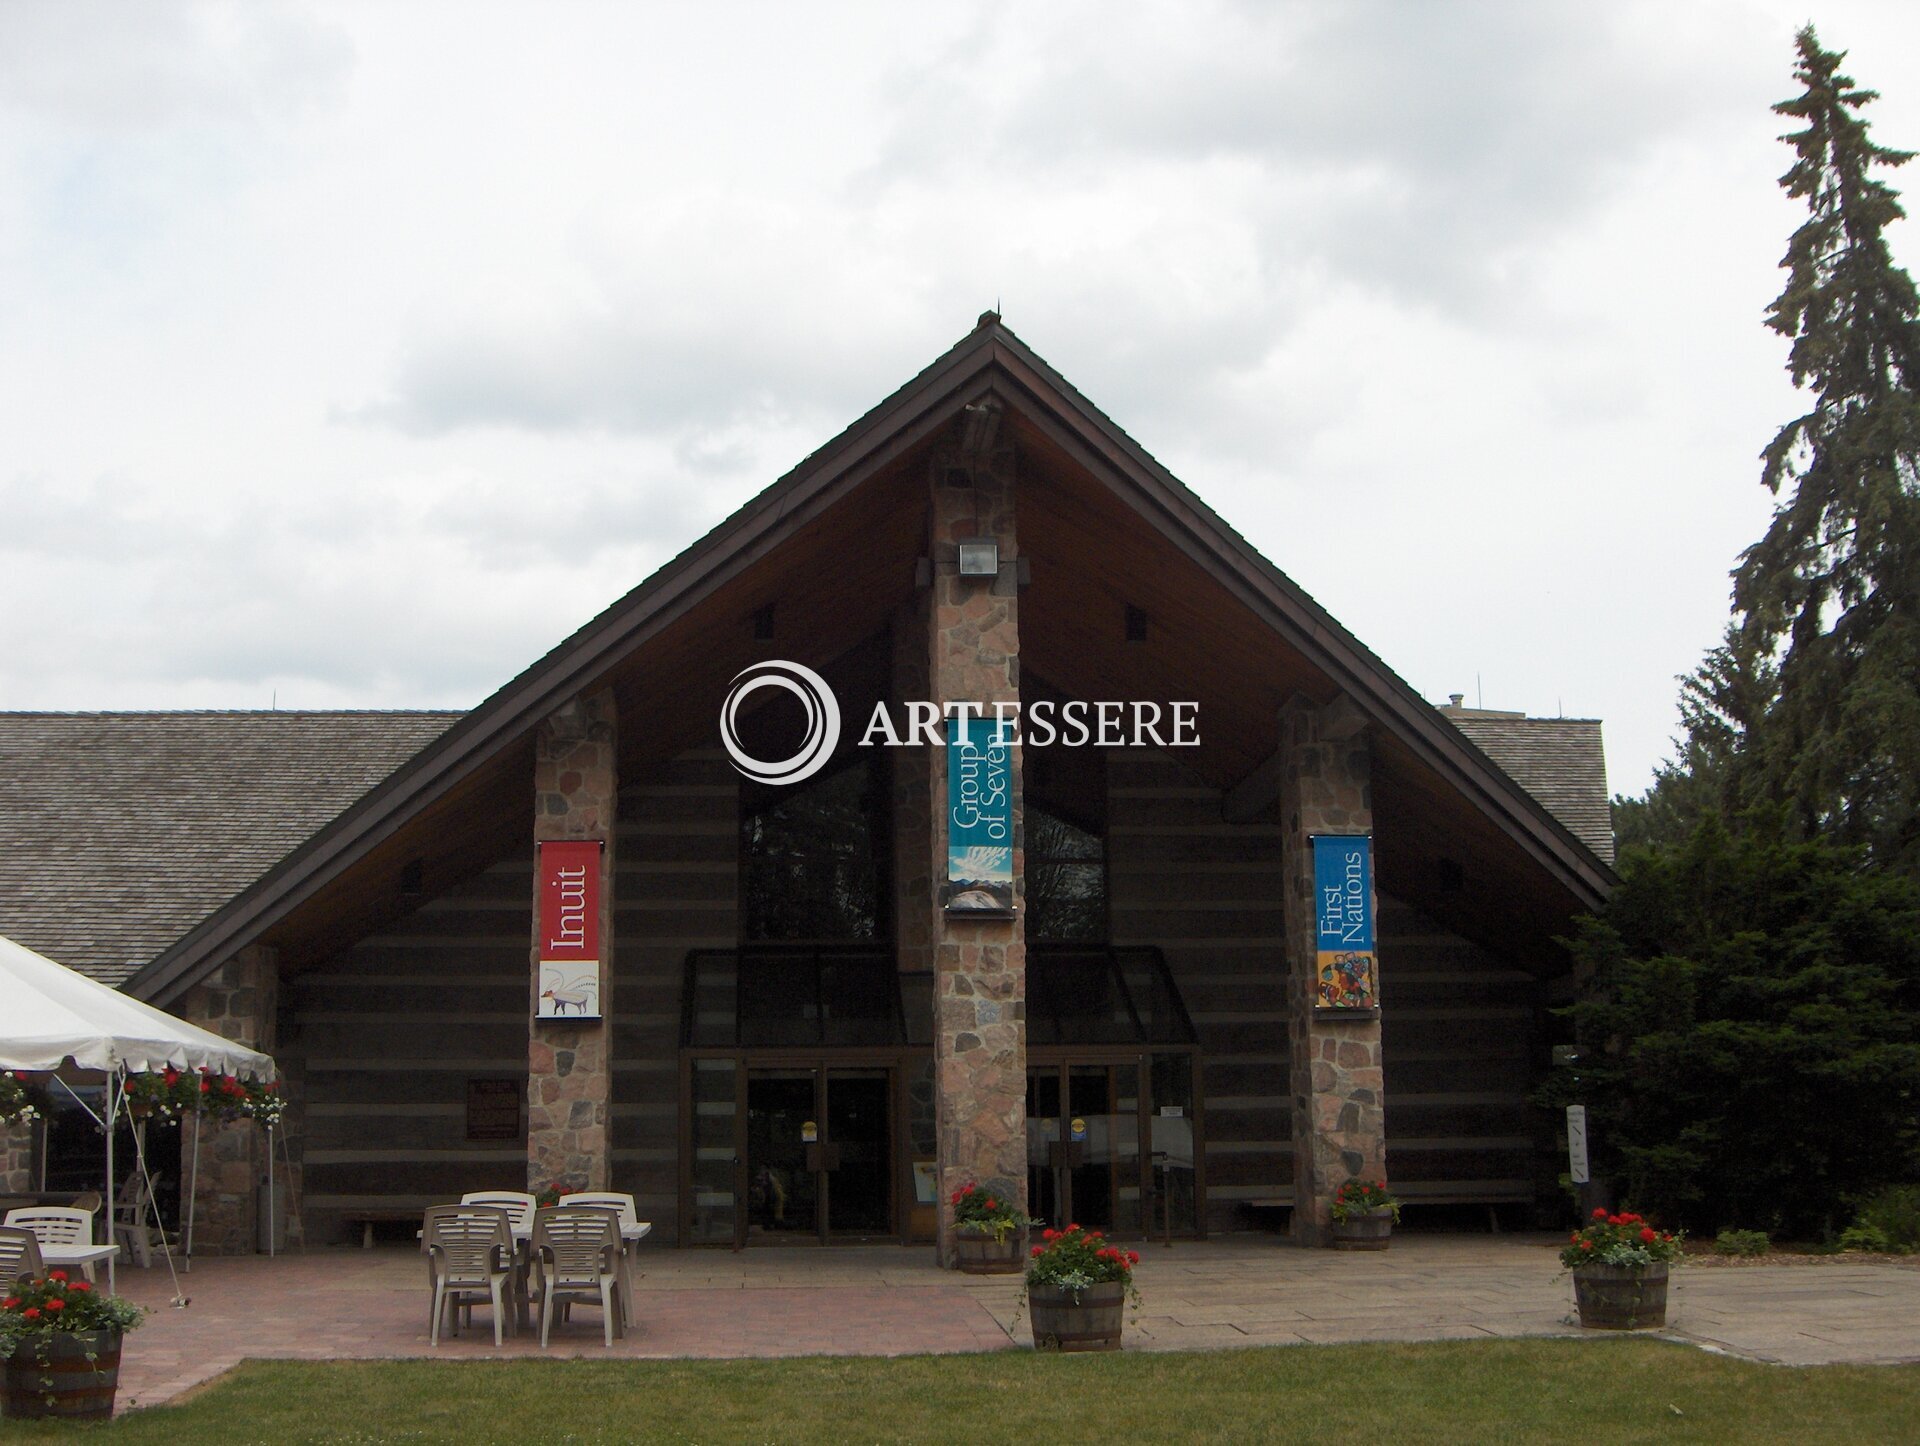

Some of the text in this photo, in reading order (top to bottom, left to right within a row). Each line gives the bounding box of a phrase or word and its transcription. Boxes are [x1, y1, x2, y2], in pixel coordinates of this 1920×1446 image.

[953, 743, 987, 829] Group
[978, 731, 1006, 840] of Seven
[550, 865, 586, 951] Inuit
[1320, 884, 1343, 937] First
[1342, 852, 1365, 944] Nations
